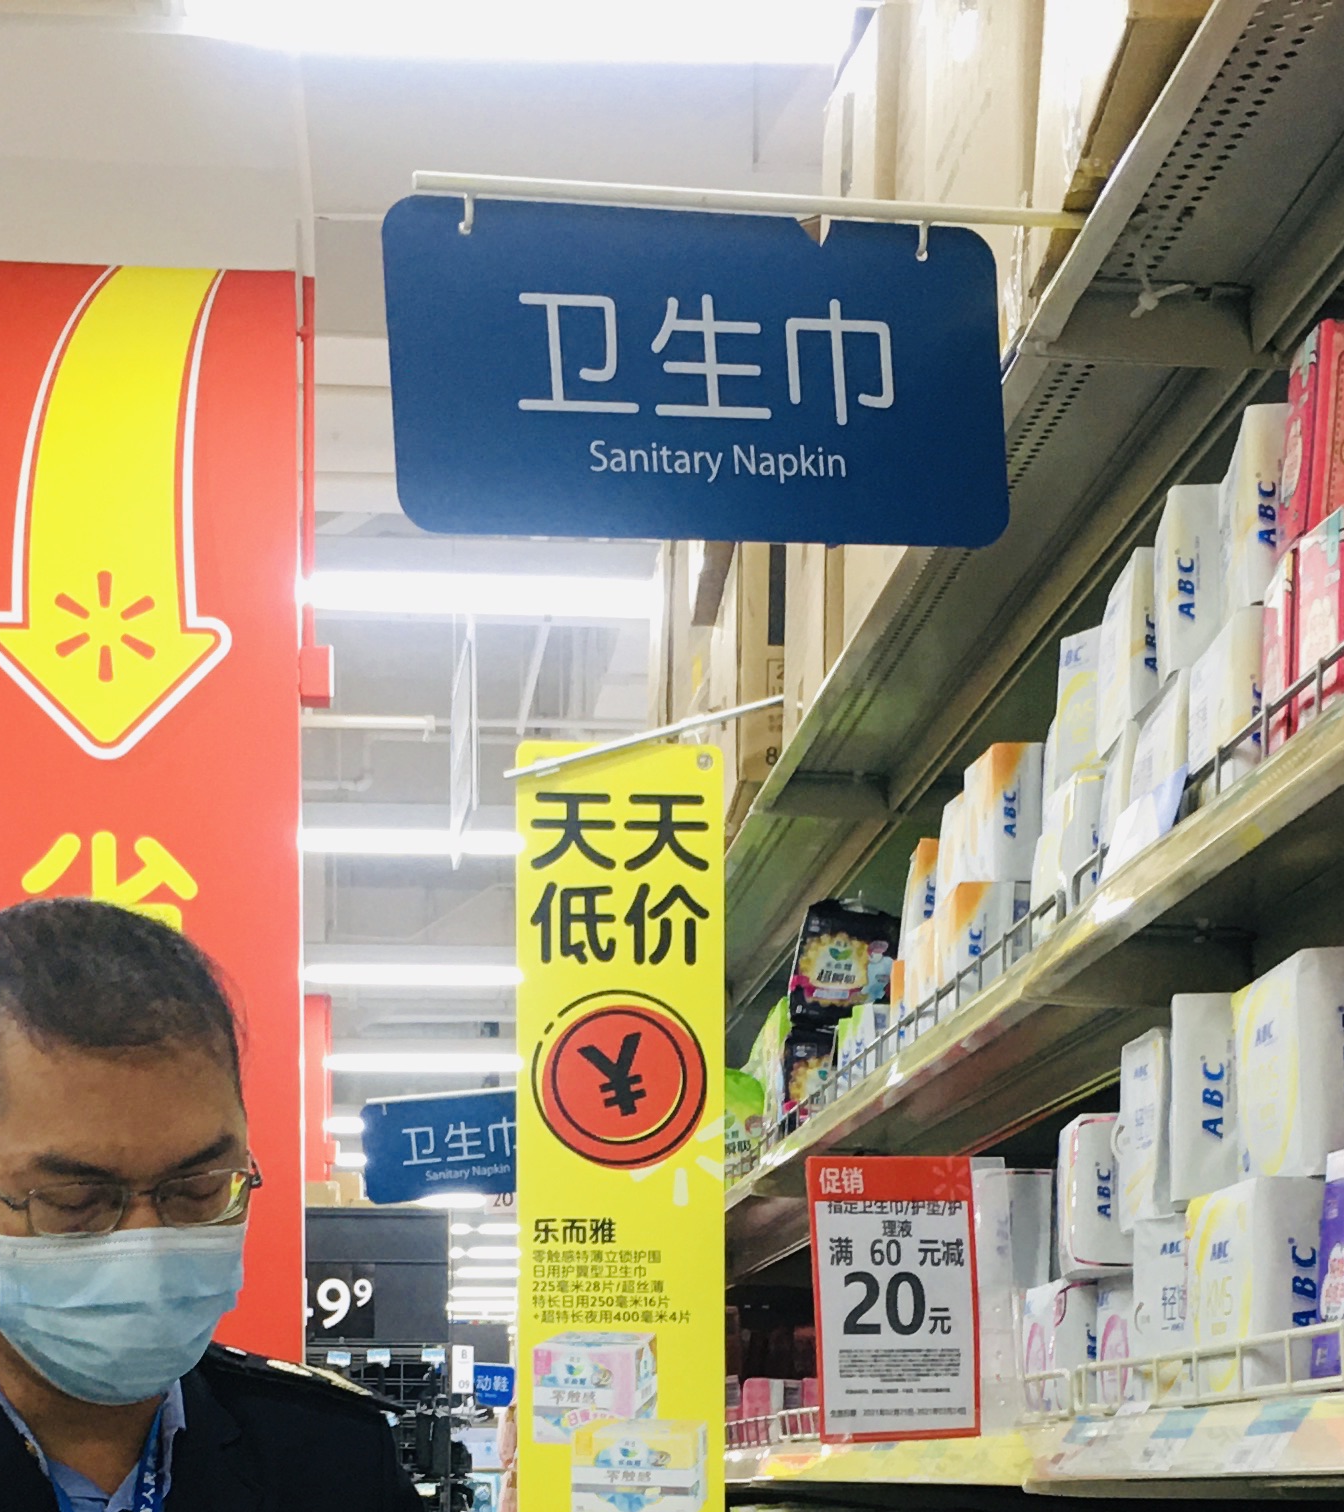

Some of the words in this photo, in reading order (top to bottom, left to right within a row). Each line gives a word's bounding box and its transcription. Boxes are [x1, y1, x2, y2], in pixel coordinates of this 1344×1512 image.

[517, 291, 896, 427] 卫生巾
[589, 439, 723, 484] Sanitary
[732, 444, 847, 484] Napkin
[1257, 479, 1278, 548] ABC
[1177, 556, 1196, 622] ABC
[530, 791, 710, 872] 天天
[1002, 789, 1019, 838] ABC
[530, 881, 710, 966] 低价
[1202, 1060, 1225, 1139] ABC
[400, 1116, 517, 1168] 卫生巾
[425, 1166, 471, 1183] Sanitary
[471, 1163, 512, 1180] Napkin
[818, 1166, 865, 1196] 促销
[1096, 1166, 1113, 1220] ABC
[532, 1216, 617, 1245] 乐而雅
[827, 1199, 963, 1216] 指定卫生巾/护垫/护
[881, 1219, 913, 1239] 理液
[532, 1264, 648, 1279] 日用护翼型卫生巾
[829, 1236, 854, 1267] 满
[869, 1238, 902, 1267] 60
[917, 1237, 965, 1268] 元减
[532, 1294, 670, 1309] 特长日用250毫米16片
[842, 1270, 927, 1336] 20
[928, 1306, 952, 1336] 元
[1291, 1244, 1318, 1328] ABC
